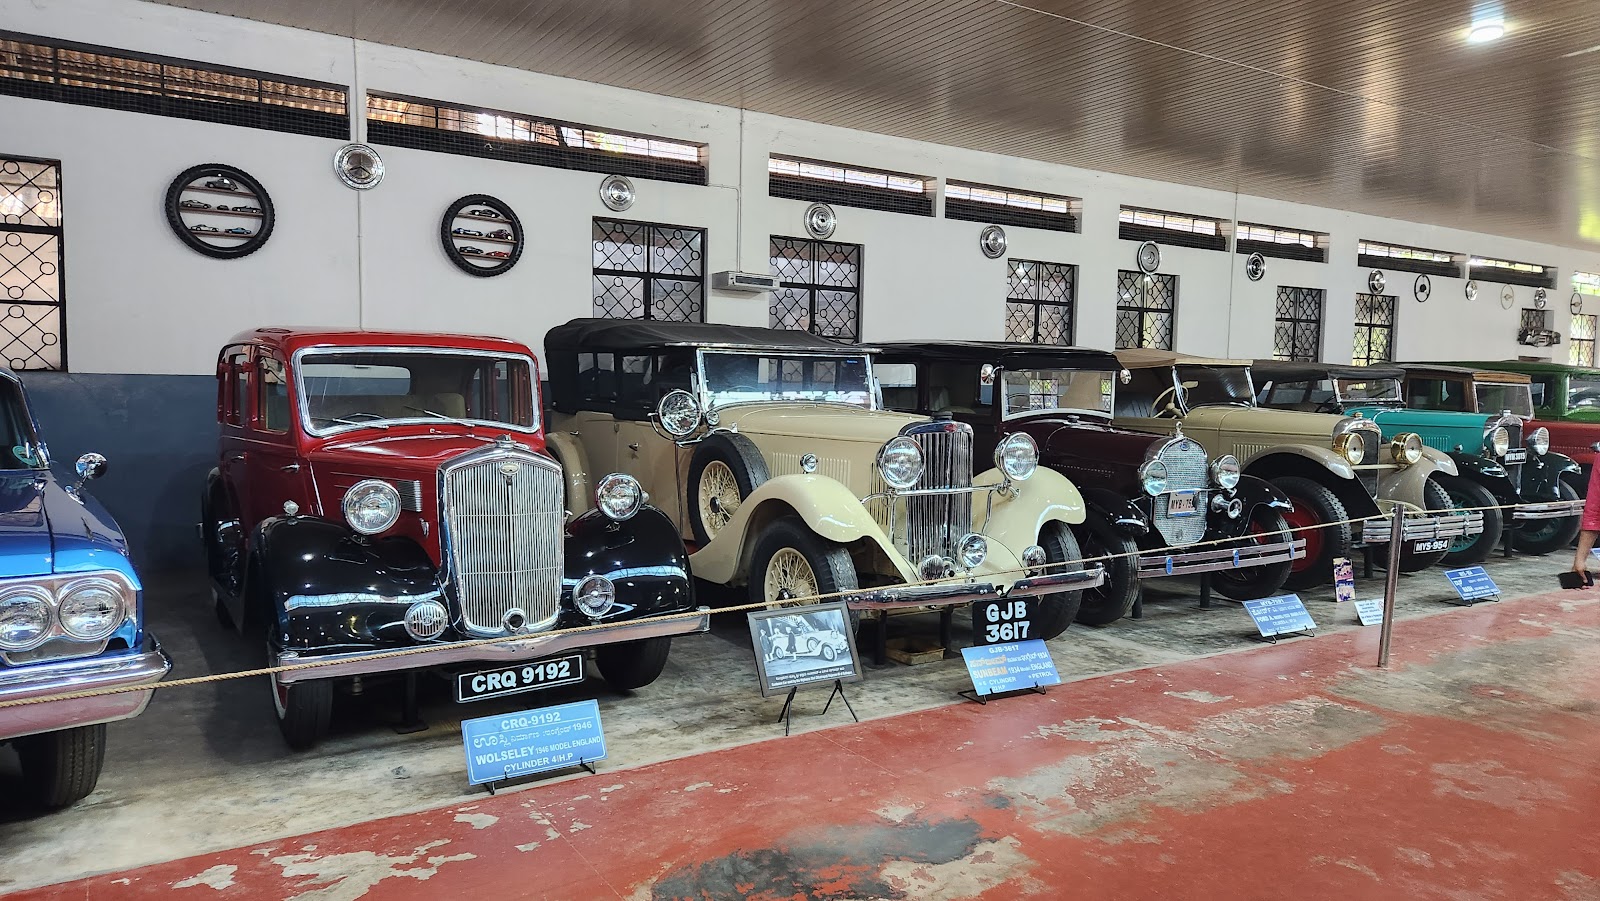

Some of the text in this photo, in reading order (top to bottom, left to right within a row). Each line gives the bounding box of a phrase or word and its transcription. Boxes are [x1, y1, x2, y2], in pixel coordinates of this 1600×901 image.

[1416, 541, 1448, 551] MYS-954
[986, 601, 1026, 622] GJB
[985, 621, 1030, 643] 3617
[989, 645, 1019, 654] GJB-3617
[471, 661, 570, 693] CRQ 9192
[973, 666, 1008, 679] SUNBEAM
[1008, 666, 1021, 674] 1934
[1031, 661, 1053, 671] ENGLAND
[1031, 671, 1053, 679] PETROL
[989, 677, 1017, 685] CYLINDER
[501, 711, 562, 731] CRQ-9192
[572, 721, 592, 731] 1946
[476, 735, 601, 766] WOLSELEY 1946 MODEL ENGLAND
[504, 758, 549, 773] CYLINDER
